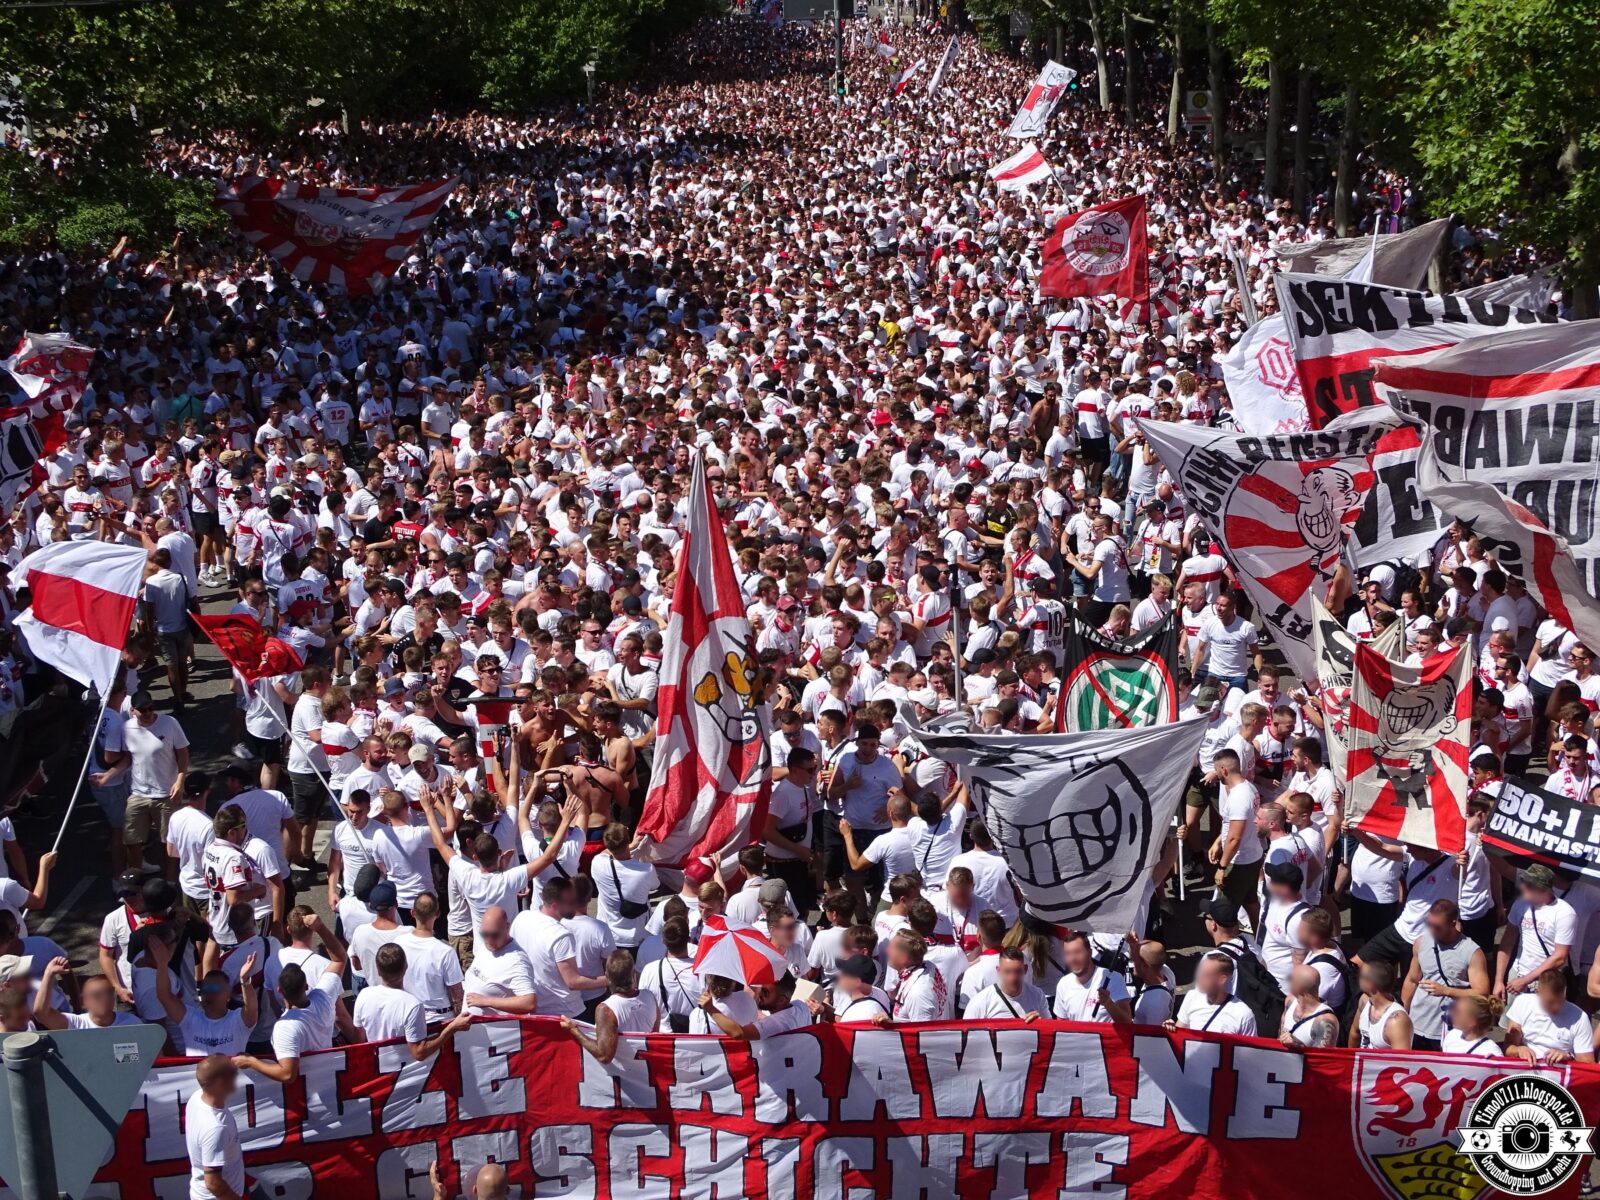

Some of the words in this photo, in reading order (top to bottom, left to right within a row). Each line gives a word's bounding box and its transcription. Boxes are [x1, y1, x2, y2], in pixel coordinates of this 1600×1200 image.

[330, 409, 345, 420] 12
[1047, 611, 1063, 637] 10
[1497, 782, 1582, 838] 50+1
[130, 1020, 527, 1162] TOLZE
[578, 1030, 1304, 1139] KARAWANE
[375, 1123, 1130, 1200] GESCHICHTE
